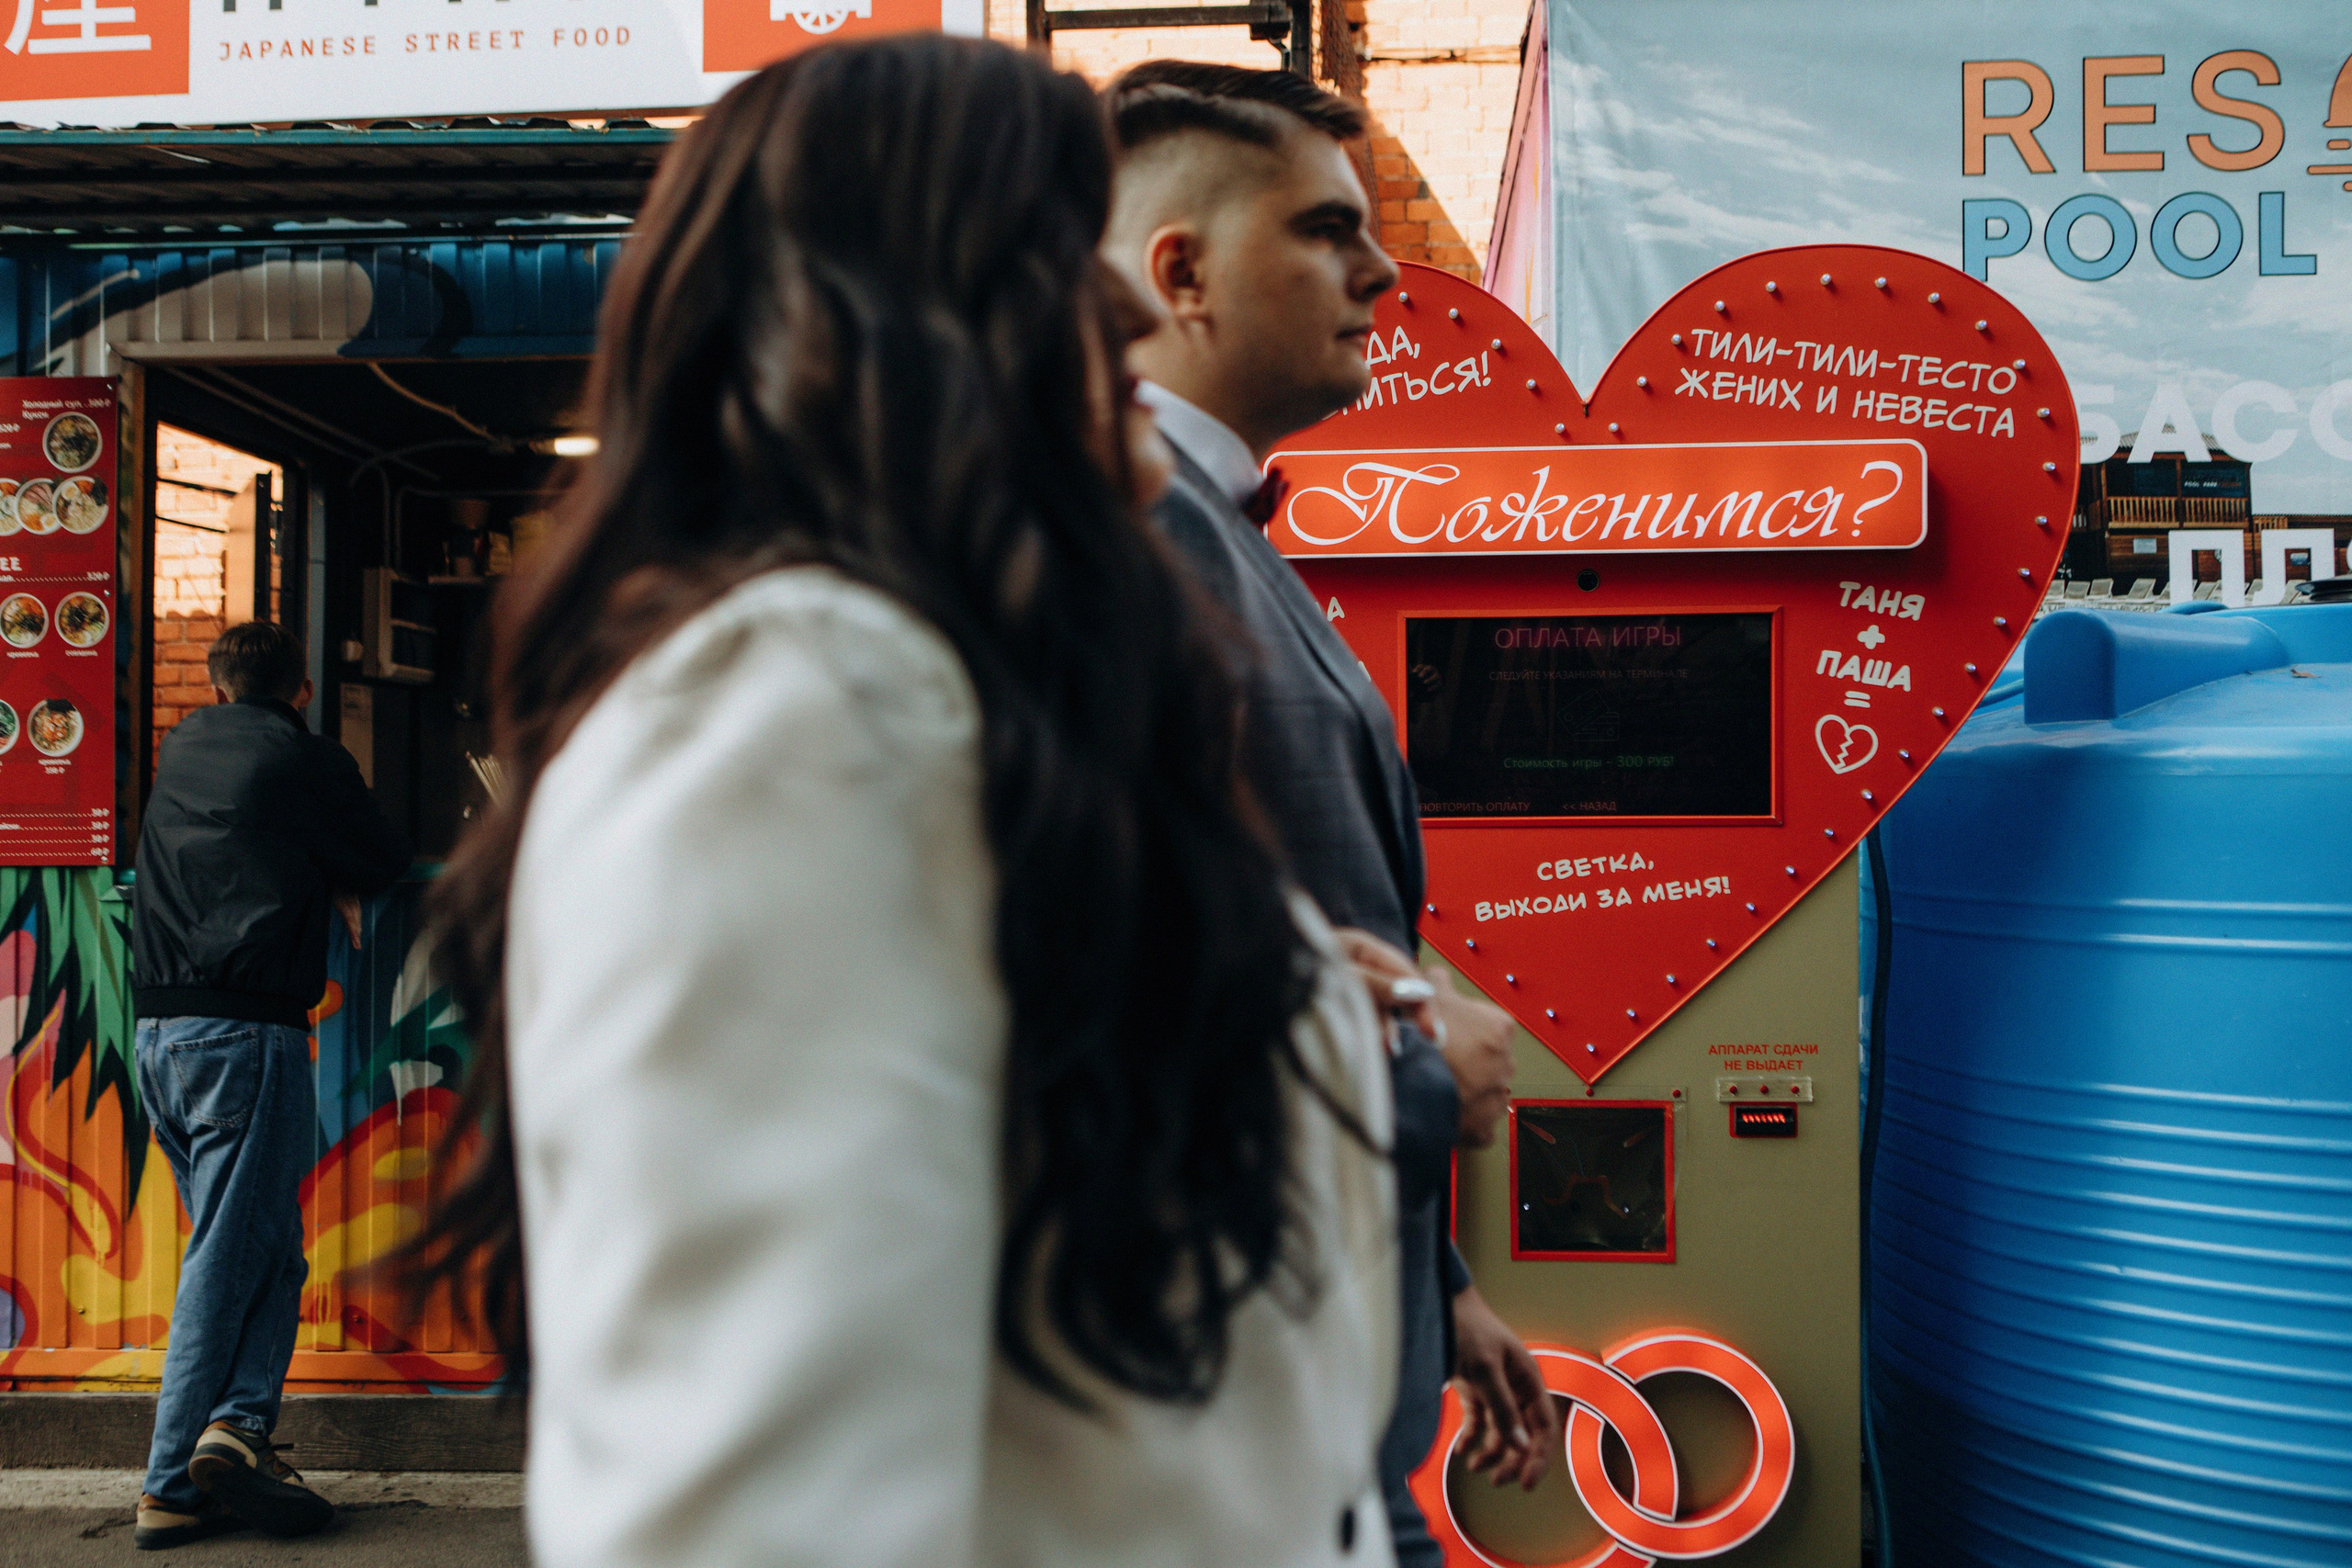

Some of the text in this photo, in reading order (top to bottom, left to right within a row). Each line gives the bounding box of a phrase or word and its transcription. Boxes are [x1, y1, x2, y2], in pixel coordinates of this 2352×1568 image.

[219, 26, 632, 62] JAPANESE STREET FOOD
[1962, 49, 2285, 176] RES
[1962, 191, 2317, 282] POOL
[1690, 329, 2018, 394] ТИЛИ-ТИЛИ-ТЕСТО
[1675, 367, 2015, 438] ЖЕНИХ И НЕВЕСТА
[1286, 460, 1903, 546] Поженимся?
[2168, 528, 2352, 607] ПЛ
[1839, 581, 1926, 621] ТАНЯ
[1494, 626, 1681, 649] ОПЛАТА ИГРЫ
[1488, 670, 1541, 682] СЛЕДУЙТЕ
[1609, 670, 1623, 680] НА
[1815, 649, 1911, 692] ПАША
[1504, 756, 1568, 770] Стоимость
[1572, 757, 1602, 771] игры
[1617, 755, 1643, 768] 300
[1486, 800, 1531, 812] ОПЛАТУ
[1580, 800, 1617, 813] НАЗАД
[1537, 852, 1654, 881] СВЕТКА,
[1475, 875, 1731, 922] ВЫХОДИ ЗА МЕНЯ!
[1709, 1043, 1818, 1056] АППАРАТ СДАЧИ
[1724, 1060, 1804, 1072] НЕ ВЫДАЕТ
